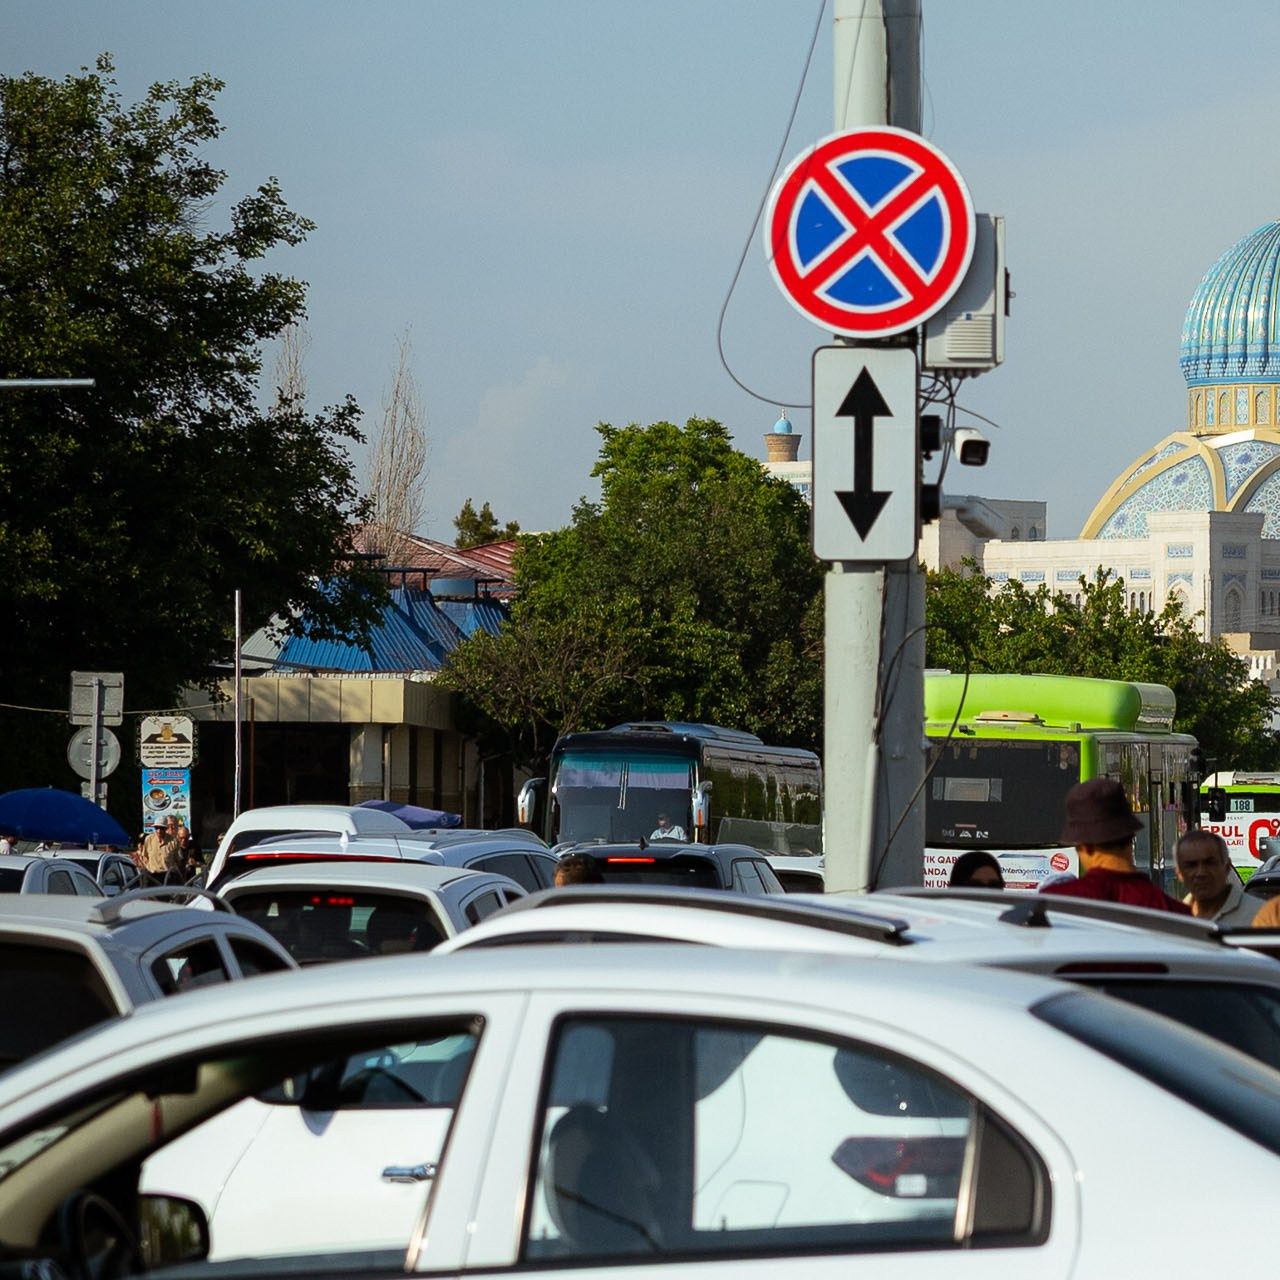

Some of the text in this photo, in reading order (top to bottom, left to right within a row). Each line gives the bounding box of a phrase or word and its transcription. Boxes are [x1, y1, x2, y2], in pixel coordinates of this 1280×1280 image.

[1234, 800, 1251, 811] 188
[1224, 839, 1244, 847] LARI
[937, 855, 959, 865] QAB
